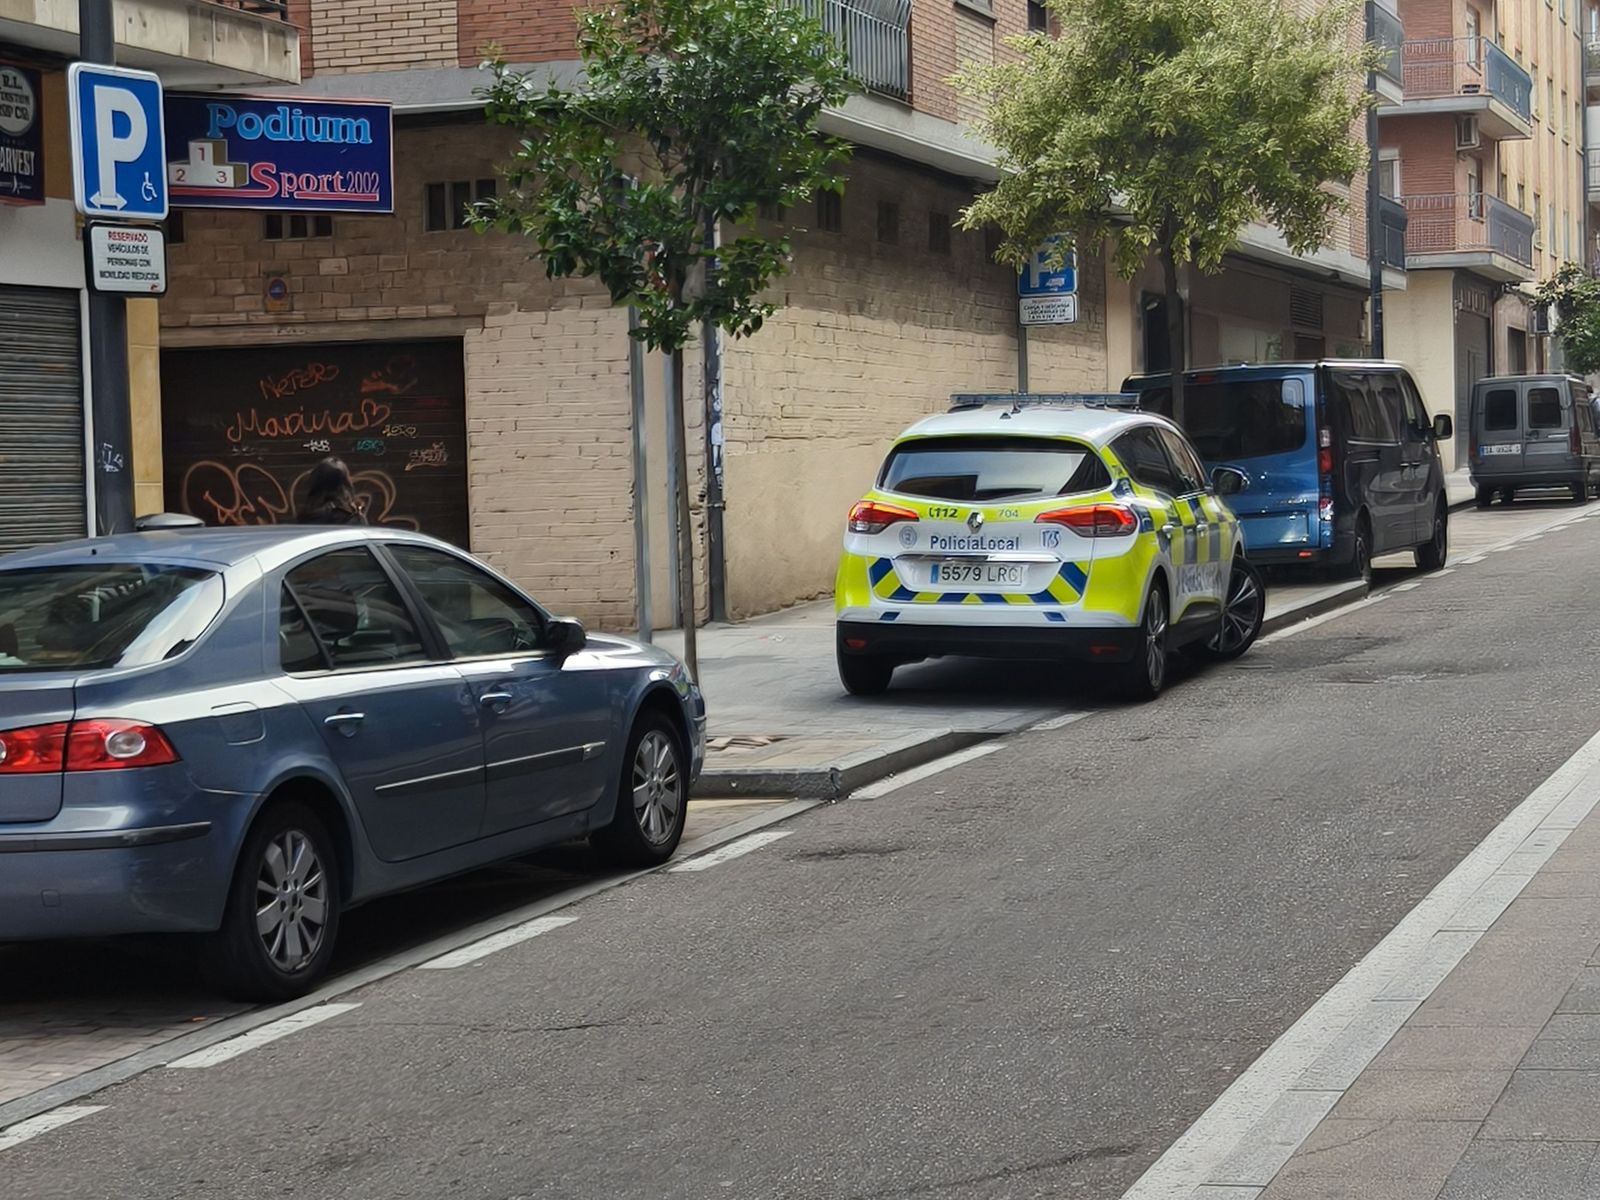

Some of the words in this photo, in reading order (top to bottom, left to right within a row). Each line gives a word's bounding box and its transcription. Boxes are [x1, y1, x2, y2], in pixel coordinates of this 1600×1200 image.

[206, 103, 373, 144] Podium
[94, 85, 148, 198] P
[197, 147, 206, 162] 1
[175, 168, 186, 182] 2
[216, 170, 227, 184] 3
[250, 162, 346, 198] Sport
[347, 171, 380, 193] 2002
[108, 231, 148, 242] RESERVADO
[999, 508, 1019, 518] 704
[941, 565, 982, 582] 5579
